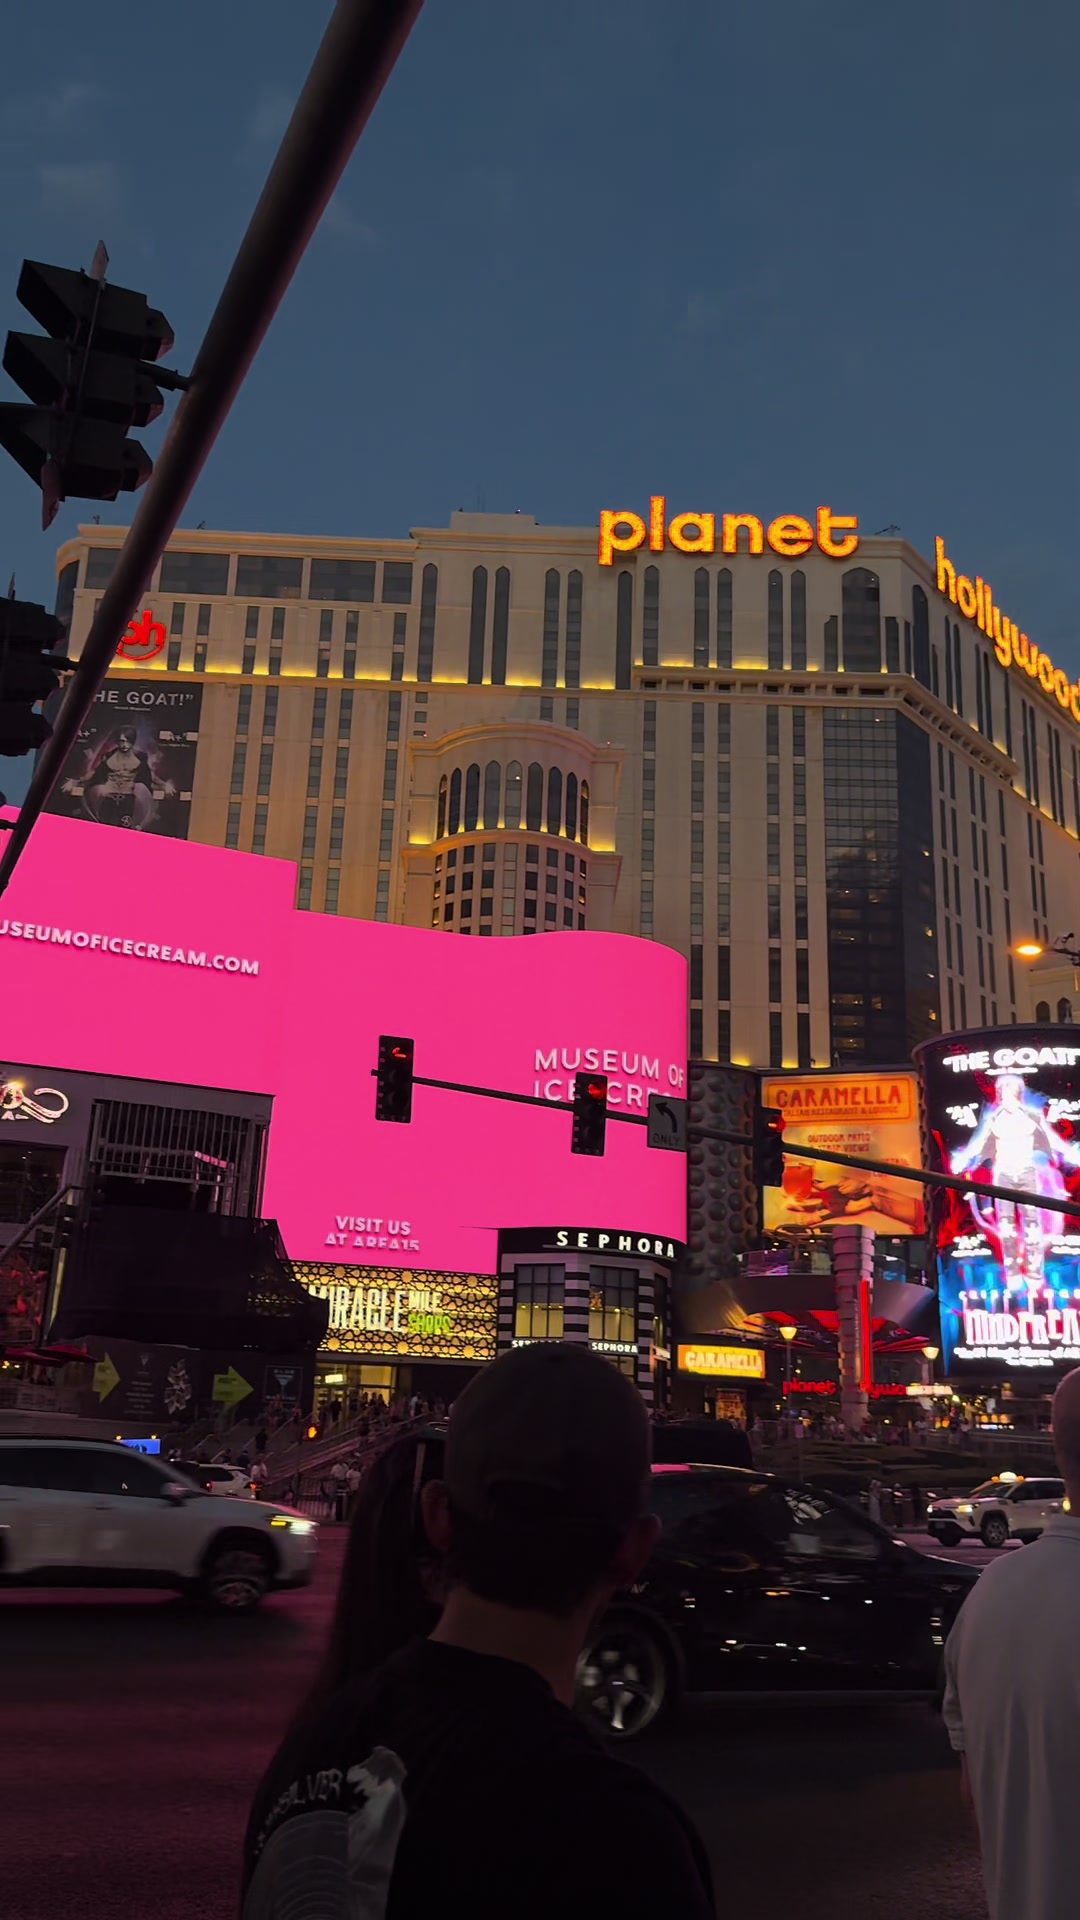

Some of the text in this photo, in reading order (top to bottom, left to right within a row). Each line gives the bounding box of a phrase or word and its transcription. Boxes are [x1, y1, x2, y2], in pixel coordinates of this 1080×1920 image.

[598, 496, 859, 567] planet
[94, 690, 119, 704] HE
[534, 1047, 684, 1089] MUSEUM OF
[775, 1085, 901, 1108] CARAMELLA
[652, 1132, 680, 1148] ONLY
[808, 1133, 871, 1143] OUTDOOR PATIO
[336, 1215, 411, 1236] VISIT US
[325, 1232, 347, 1246] AT
[556, 1230, 676, 1259] SEPHORA
[408, 1290, 442, 1313] MILE
[408, 1313, 452, 1335] SHOPS
[591, 1342, 638, 1353] SEPHORA
[685, 1351, 763, 1373] CARAMELLA
[782, 1377, 838, 1397] planet
